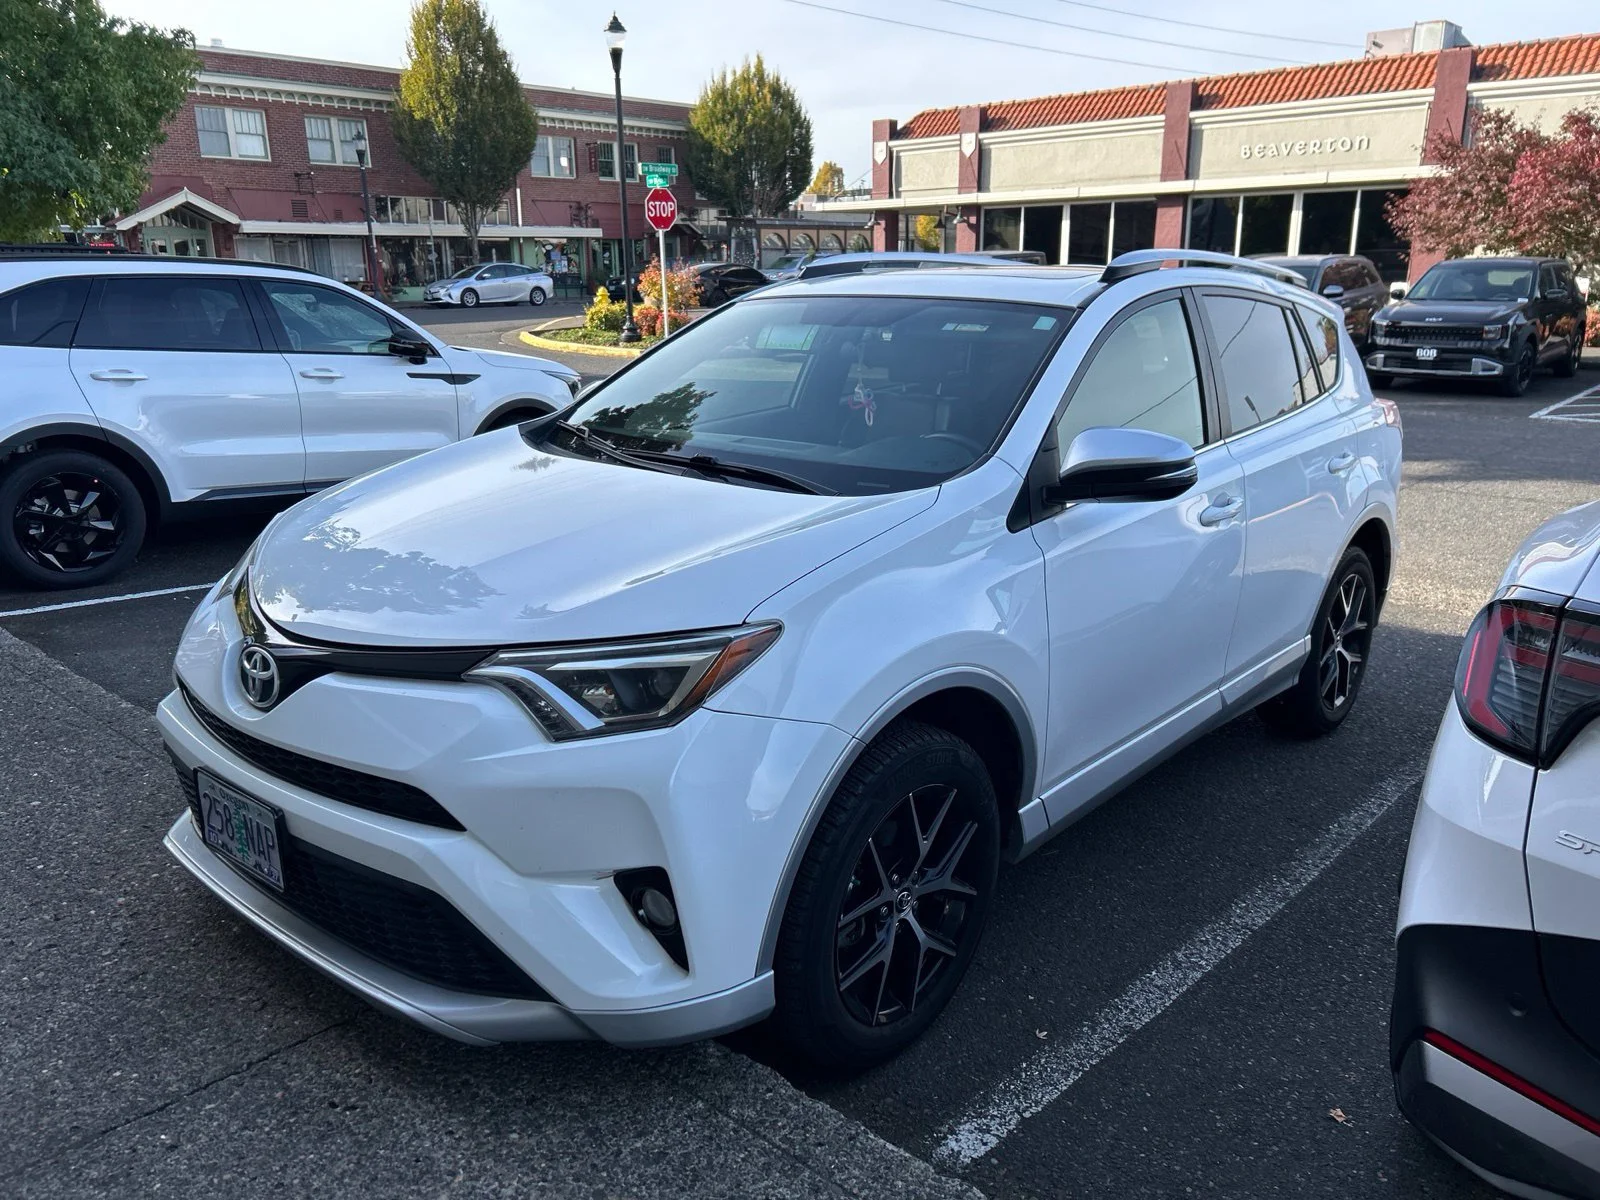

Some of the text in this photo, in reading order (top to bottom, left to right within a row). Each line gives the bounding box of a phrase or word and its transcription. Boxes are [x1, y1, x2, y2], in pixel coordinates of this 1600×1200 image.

[649, 164, 671, 174] Broadway
[648, 201, 675, 217] STOP
[202, 791, 275, 862] 258 NAP
